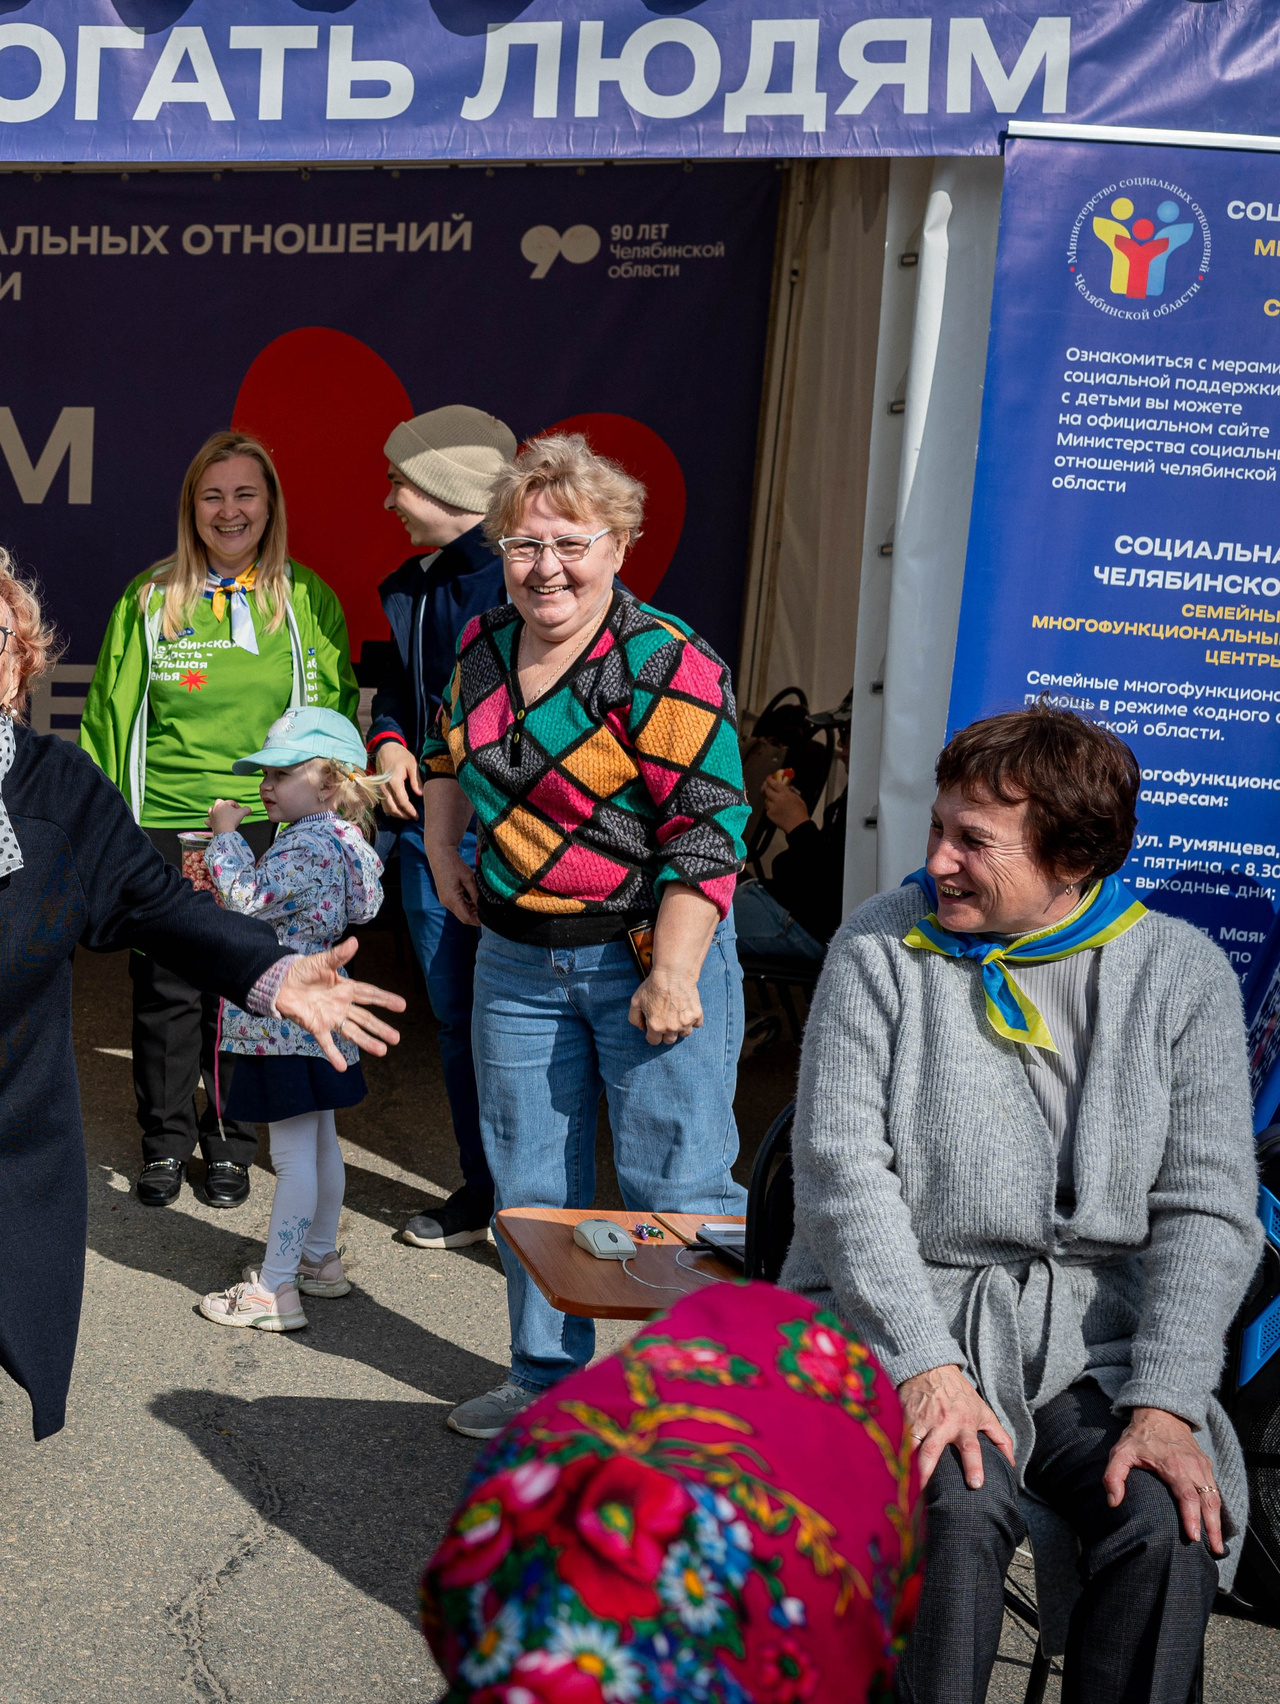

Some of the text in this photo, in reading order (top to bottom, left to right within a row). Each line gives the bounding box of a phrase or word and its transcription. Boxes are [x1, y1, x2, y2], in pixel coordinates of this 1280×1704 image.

[459, 16, 1072, 134] ЛЮДЯМ
[181, 213, 473, 256] ОТНОШЕНИЙ
[610, 223, 670, 241] 90 ЛЕТ
[1066, 177, 1212, 274] Министерство социальных отношений
[609, 241, 726, 260] Челябинской
[607, 263, 680, 279] области
[1074, 273, 1201, 320] Челябинской области
[1066, 347, 1194, 370] Ознакомиться
[1198, 358, 1207, 370] с
[1063, 370, 1171, 389] социальной
[1061, 391, 1243, 415] с детьми вы можете
[1058, 412, 1271, 439] на официальном сайте
[1056, 431, 1280, 461] Министерства социальн
[1054, 455, 1278, 482] отношений челябинской
[1051, 474, 1127, 493] области
[1031, 614, 1280, 647] МНОГОФУНКЦИОНАЛЬНЫ
[1026, 670, 1119, 691] Семейные
[1099, 699, 1110, 711] в
[1114, 699, 1188, 717] режиме
[1143, 721, 1225, 741] области.
[1140, 768, 1280, 790] огофункцион
[1140, 789, 1229, 808] адресам:
[1135, 834, 1280, 860] ул. Румянцева,
[1143, 856, 1226, 876] пятница,
[1231, 865, 1240, 875] с
[1135, 876, 1231, 896] выходные
[1235, 885, 1276, 901] дни;
